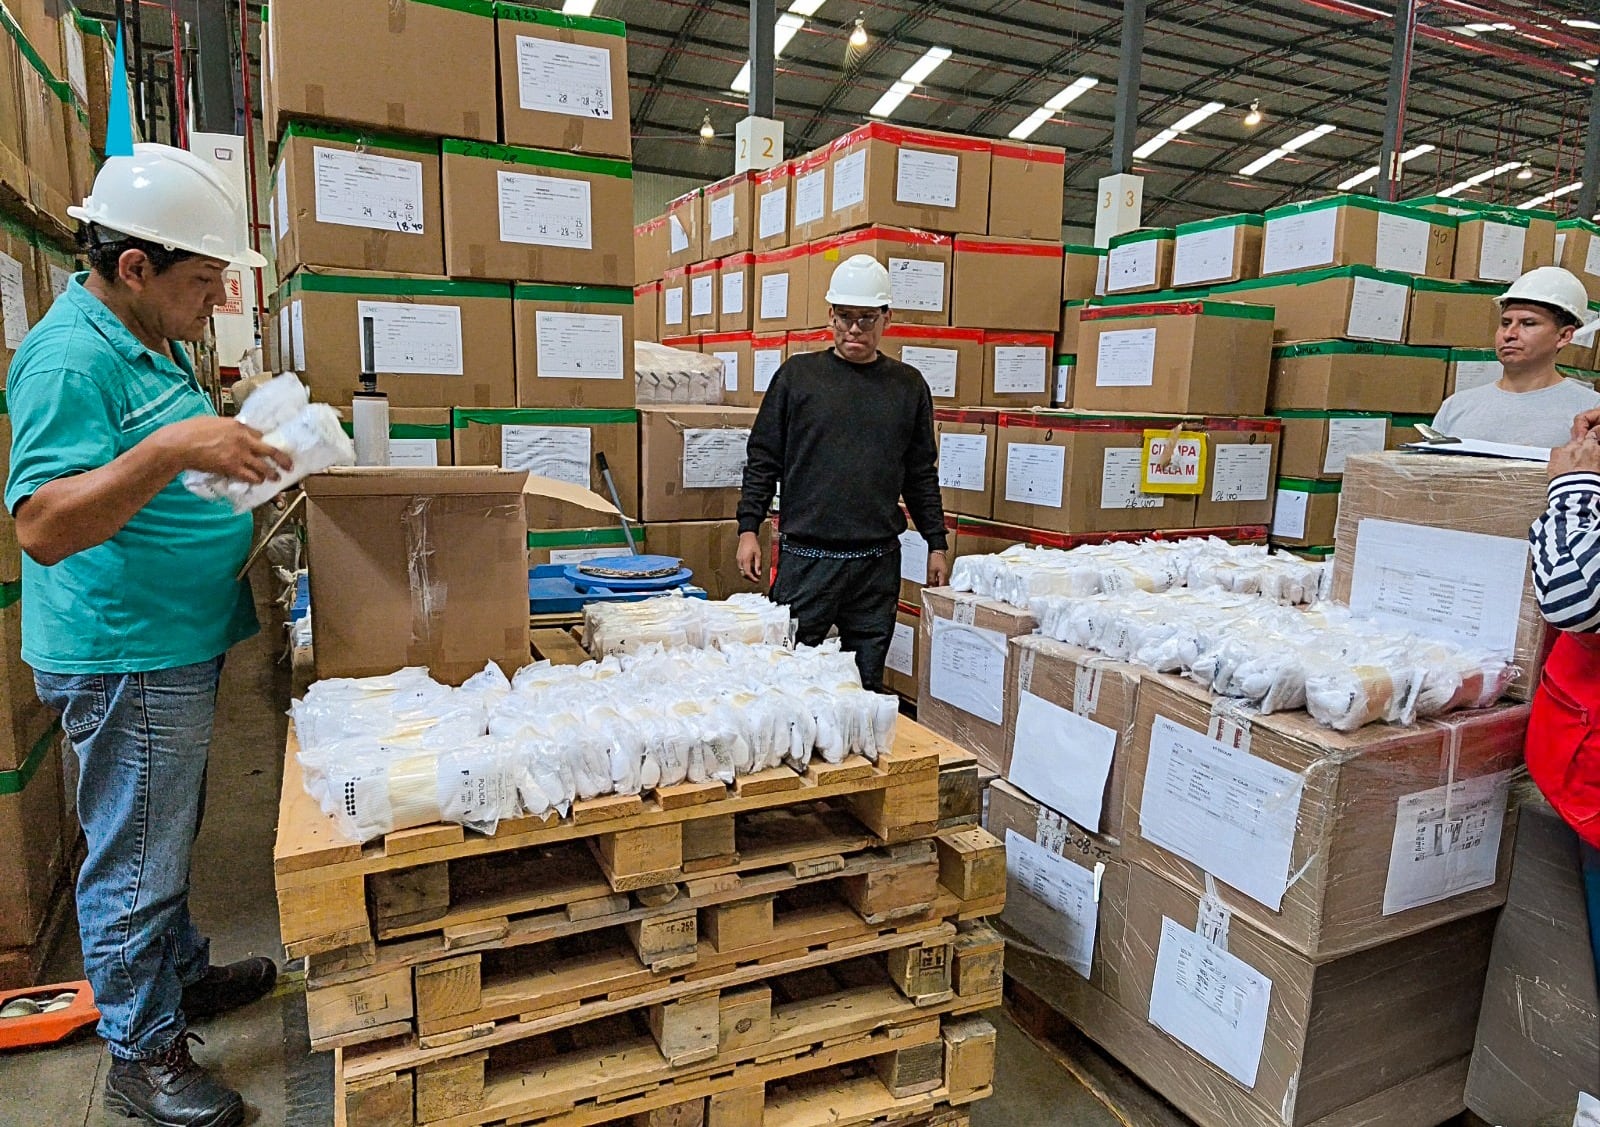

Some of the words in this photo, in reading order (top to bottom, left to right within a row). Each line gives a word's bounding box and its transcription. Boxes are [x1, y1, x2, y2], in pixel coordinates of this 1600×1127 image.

[762, 136, 774, 157] 2
[1103, 191, 1112, 209] 3
[1126, 190, 1134, 207] 3
[1151, 443, 1196, 457] CPA
[1150, 463, 1183, 475] TALLA
[1185, 464, 1195, 476] M
[478, 778, 487, 807] POLICIA
